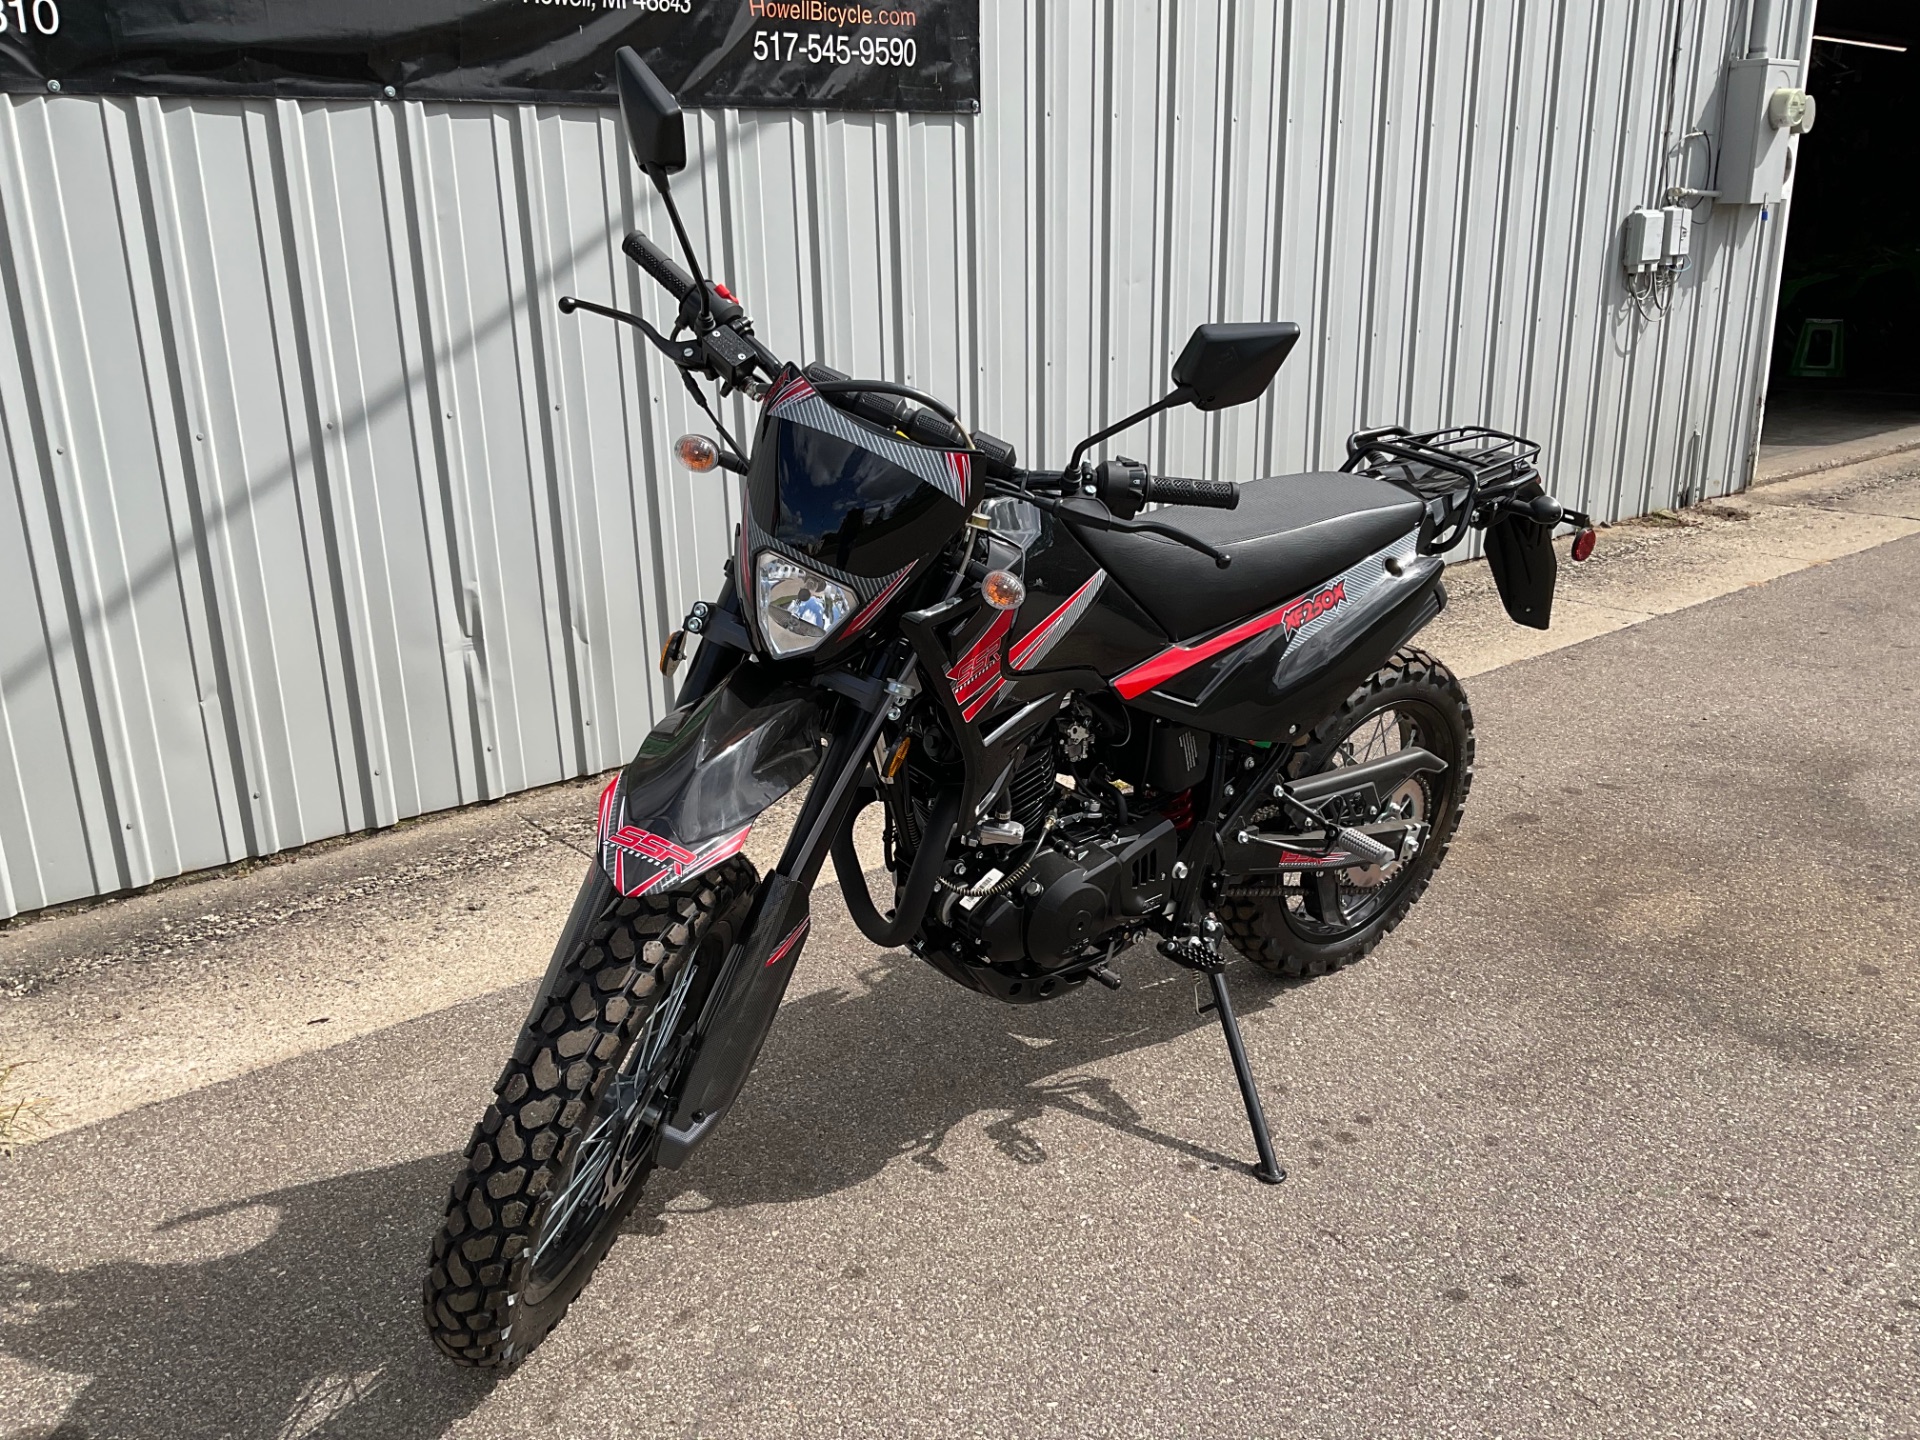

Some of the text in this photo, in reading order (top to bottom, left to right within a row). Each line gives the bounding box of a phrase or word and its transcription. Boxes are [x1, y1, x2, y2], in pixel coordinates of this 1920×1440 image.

[0, 0, 59, 35] 10
[749, 0, 916, 28] HowellBicycle.com
[753, 30, 917, 67] 517-545-9590
[1282, 577, 1348, 638] XF250X
[607, 824, 698, 877] SSR
